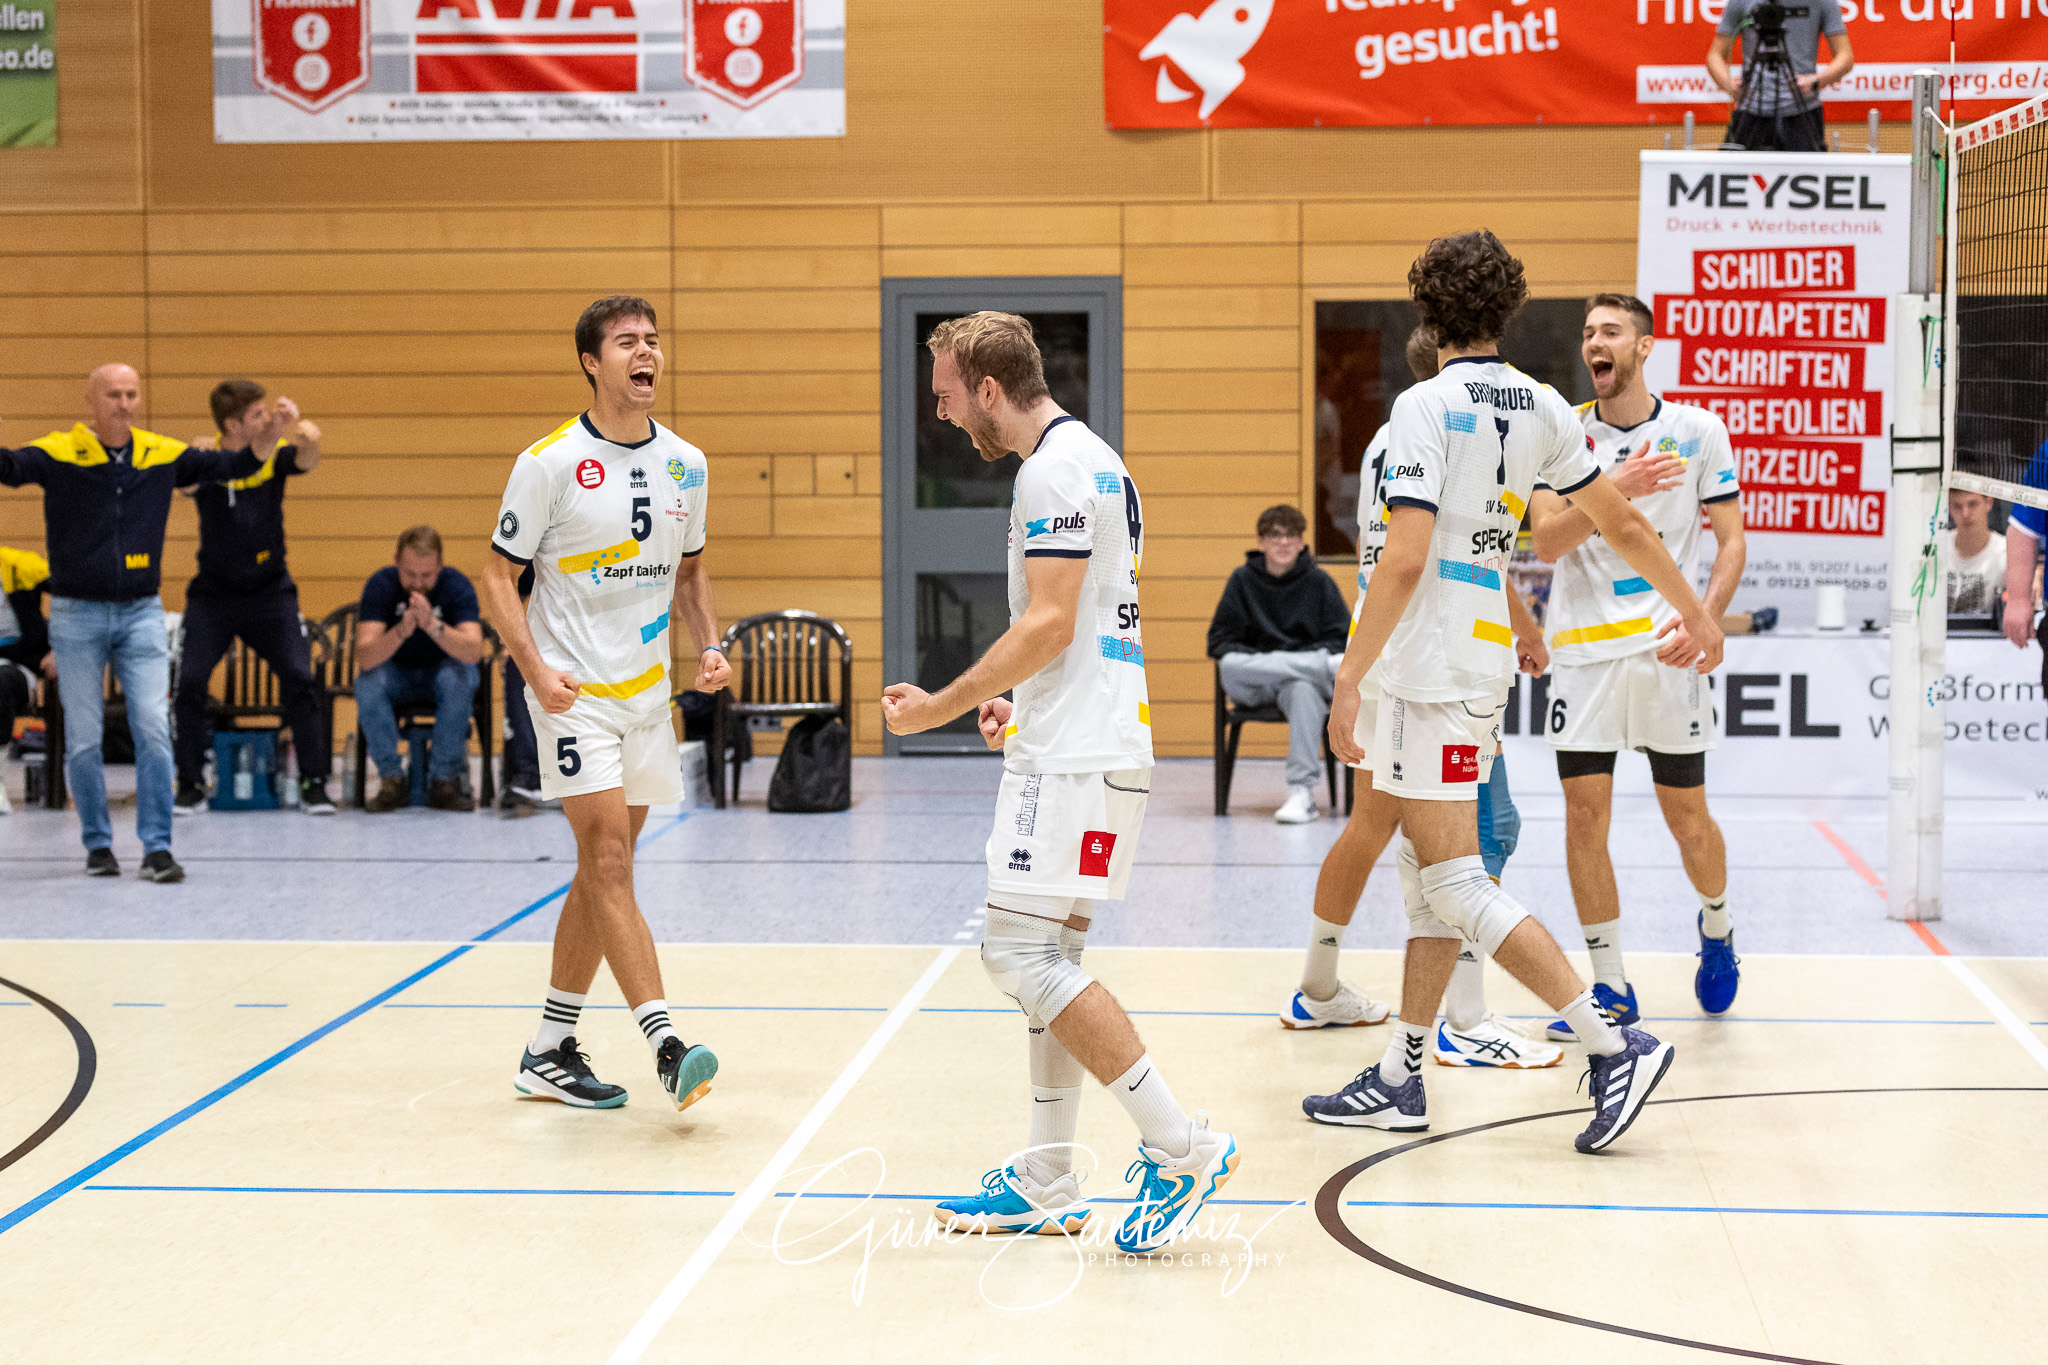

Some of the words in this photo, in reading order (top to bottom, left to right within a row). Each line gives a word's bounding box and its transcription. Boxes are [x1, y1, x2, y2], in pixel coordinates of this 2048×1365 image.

[0, 4, 44, 29] llen
[1355, 7, 1559, 79] gesucht!
[1669, 173, 1886, 210] MEYSEL
[1666, 217, 1722, 233] Druck
[1748, 218, 1882, 235] Werbetechnik
[1701, 250, 1844, 290] SCHILDER
[1666, 300, 1870, 339] FOTOTAPETEN
[1694, 347, 1850, 388] SCHRIFTEN
[1678, 397, 1867, 435] EBEFOLIEN
[1494, 416, 1510, 486] 7
[1734, 446, 1856, 487] RZEUG-
[1396, 463, 1425, 480] puls
[631, 497, 652, 542] 5
[1053, 511, 1086, 533] puls
[1123, 476, 1142, 554] 4
[1740, 489, 1881, 532] HRIFTUNG
[604, 565, 634, 579] Zapf
[1118, 603, 1140, 630] SP
[1551, 699, 1567, 734] 6
[557, 736, 581, 777] 5
[1009, 862, 1031, 872] errea
